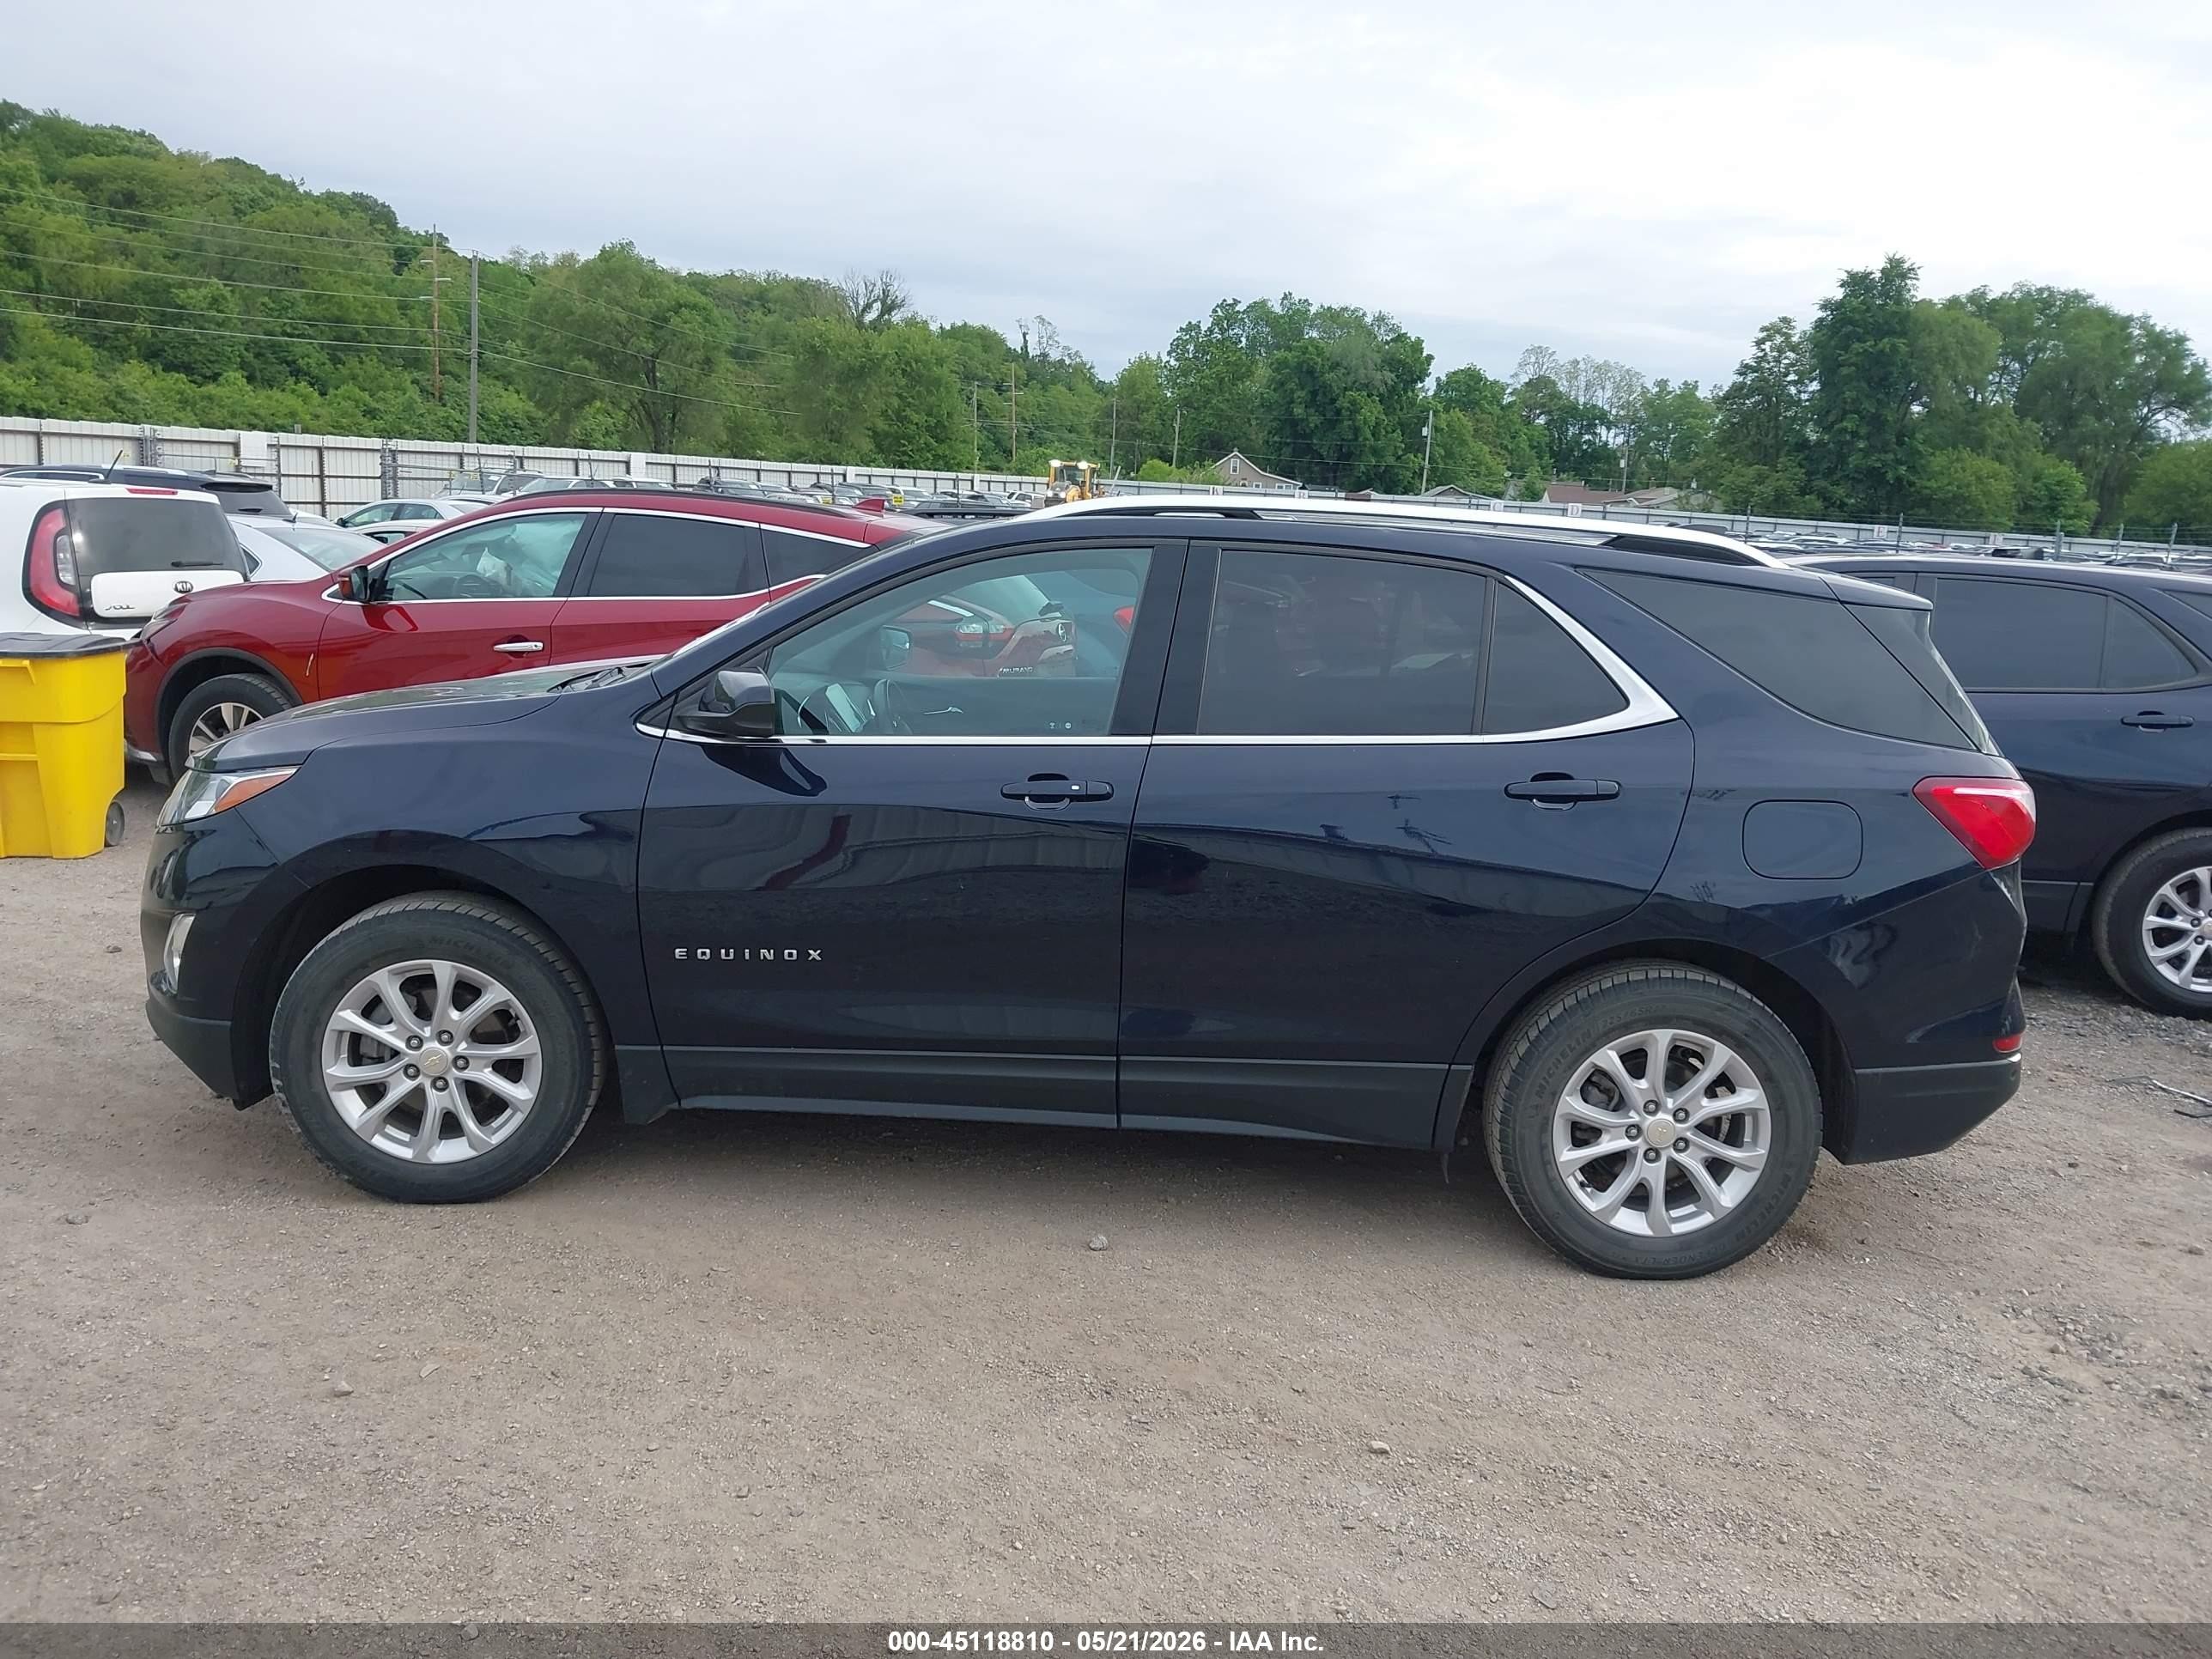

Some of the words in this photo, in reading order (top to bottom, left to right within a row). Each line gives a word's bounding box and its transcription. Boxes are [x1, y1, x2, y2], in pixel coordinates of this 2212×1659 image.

[1571, 505, 1580, 516] D
[175, 582, 192, 592] KIA
[674, 948, 822, 961] EQUINOX
[1534, 1029, 1592, 1099] MICHELIN
